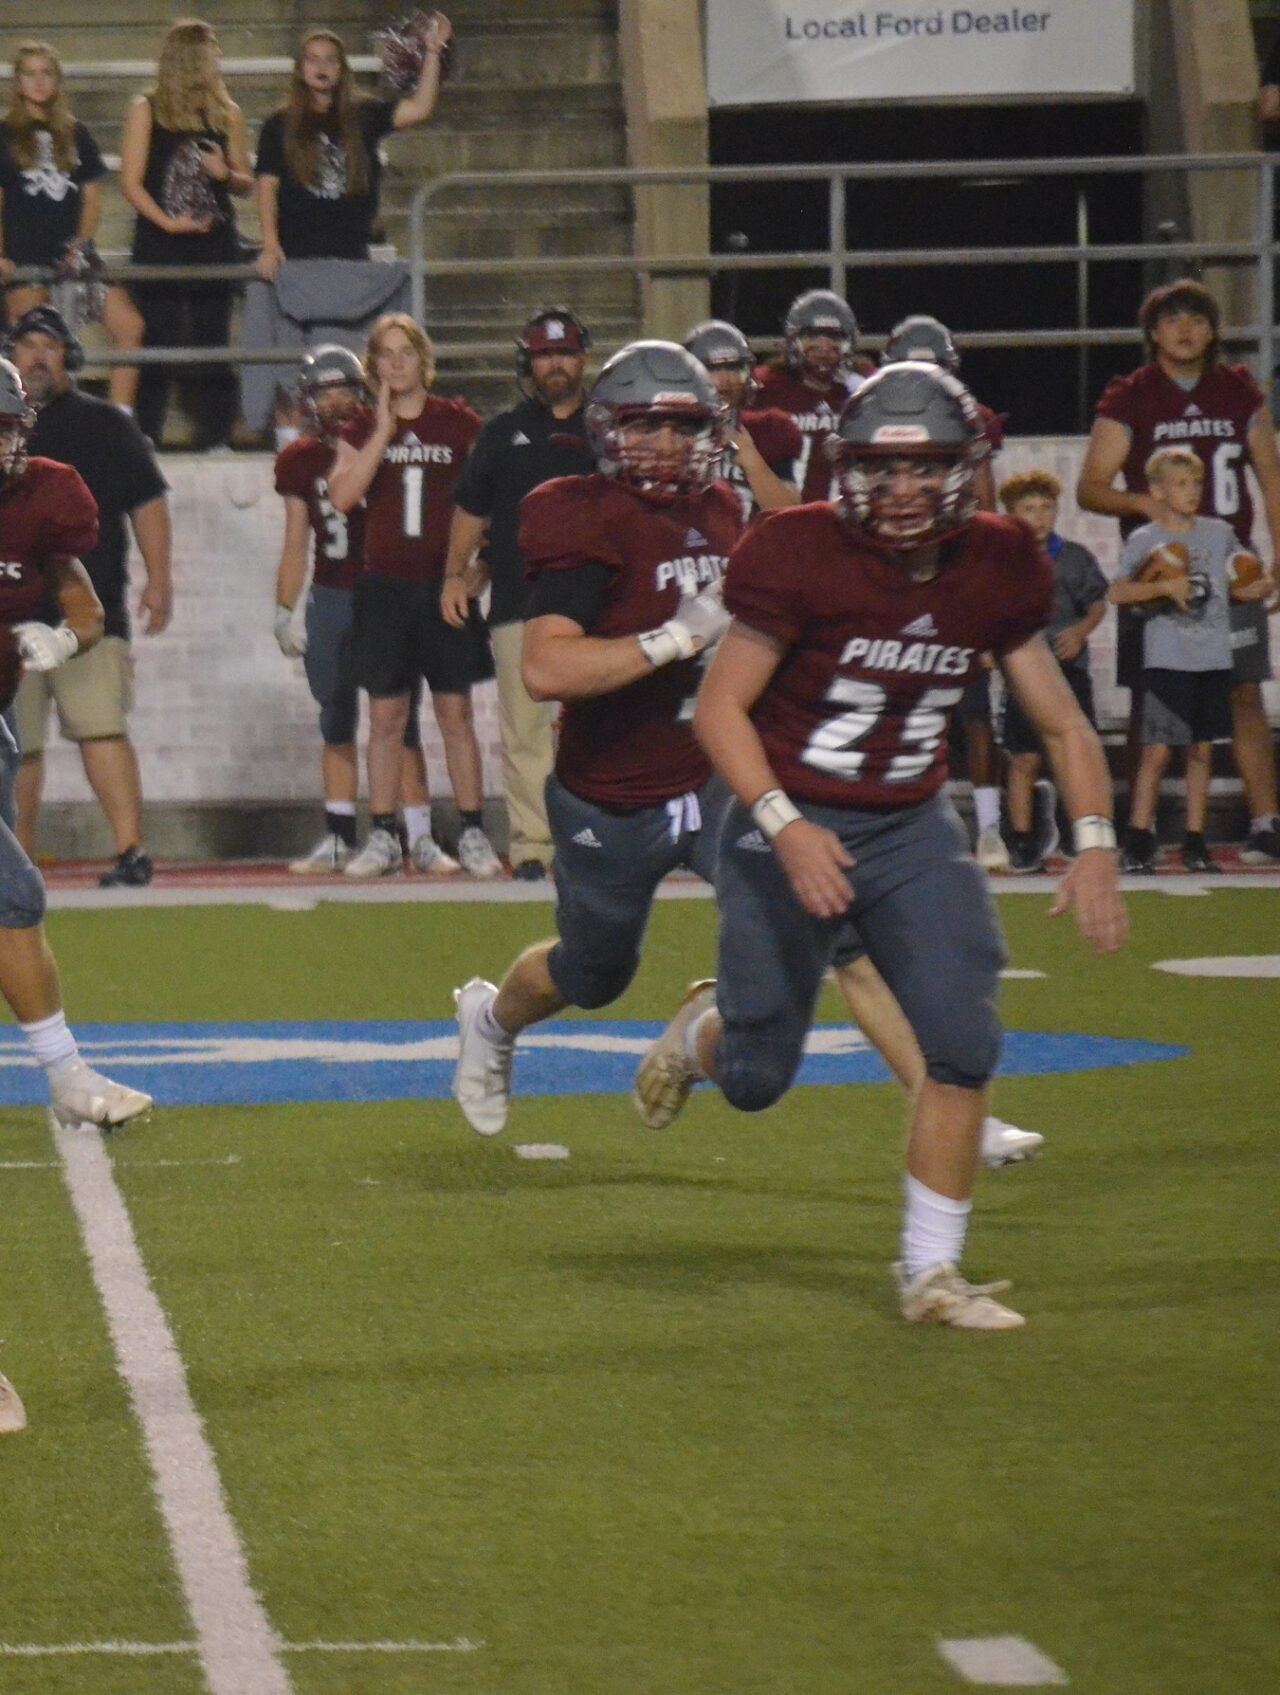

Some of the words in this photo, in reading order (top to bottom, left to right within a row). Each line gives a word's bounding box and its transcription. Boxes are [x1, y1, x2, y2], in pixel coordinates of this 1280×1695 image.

[785, 12, 868, 39] Local
[875, 11, 944, 37] Ford
[952, 9, 1051, 34] Dealer
[1153, 421, 1236, 440] PIRATES
[403, 465, 424, 537] 1
[838, 637, 975, 676] PIRATES
[801, 676, 965, 782] 25
